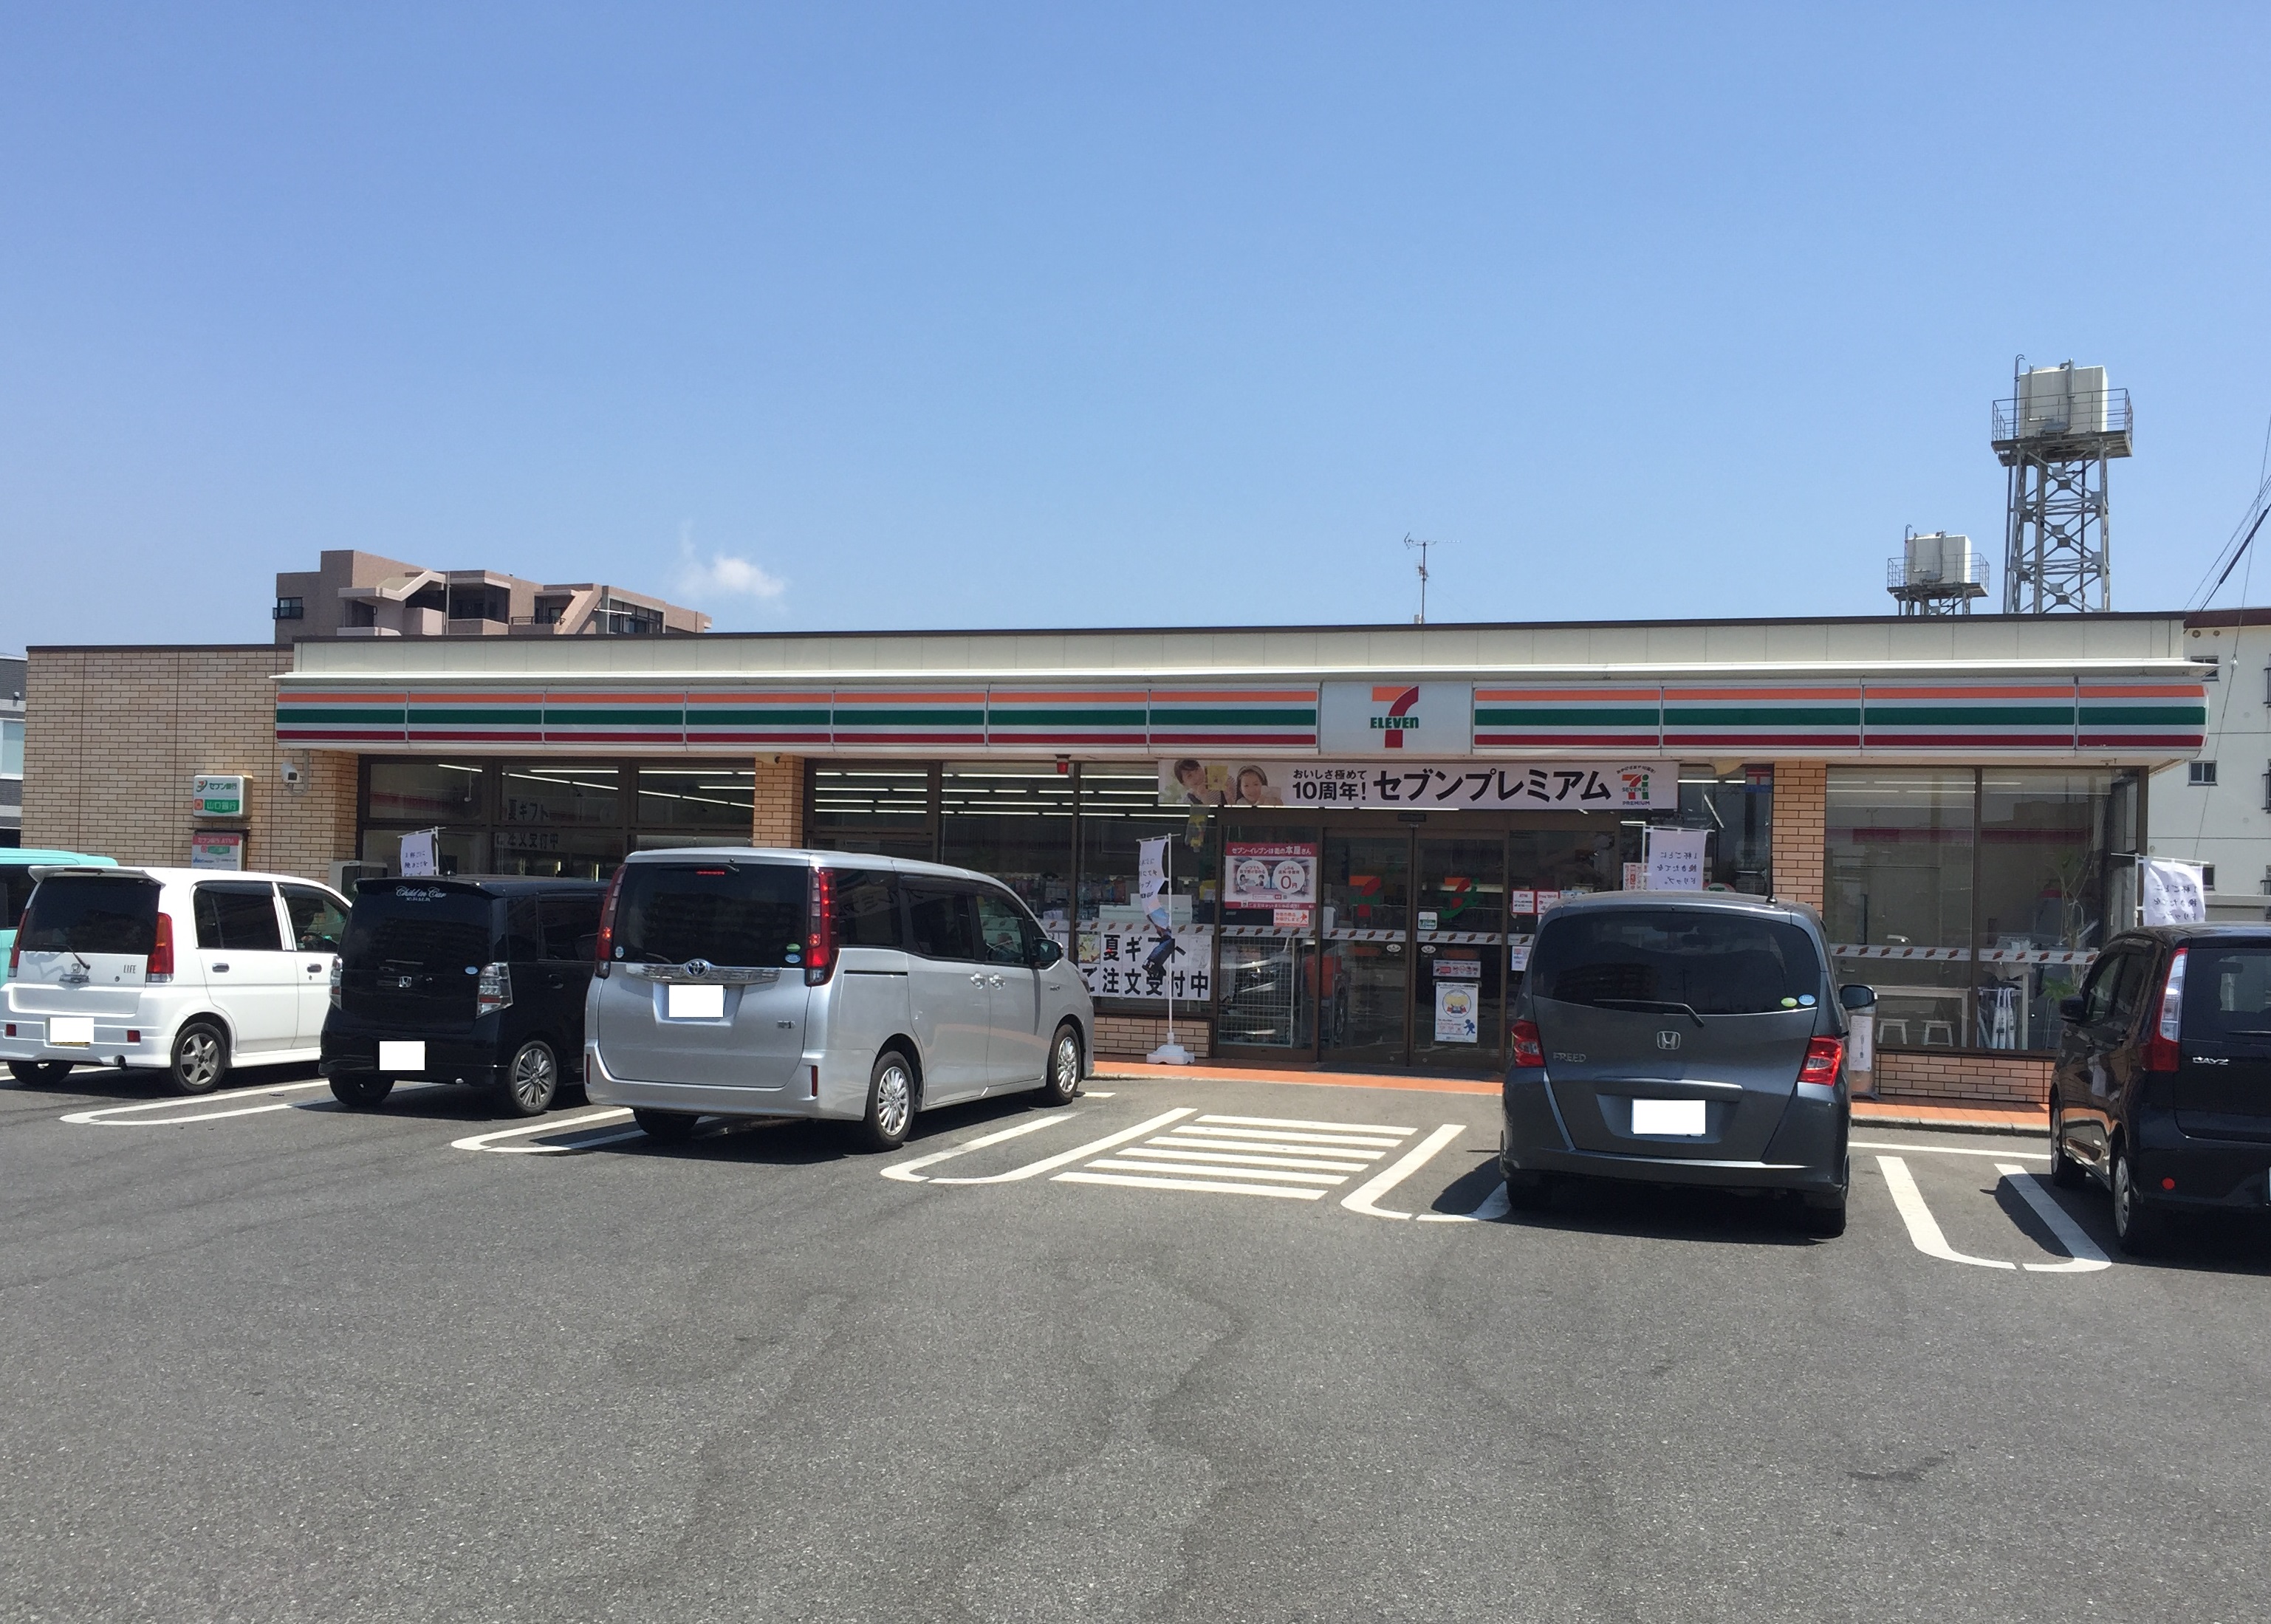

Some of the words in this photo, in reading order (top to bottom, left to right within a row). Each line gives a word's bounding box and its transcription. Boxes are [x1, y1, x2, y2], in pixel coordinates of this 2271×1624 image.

[1293, 769, 1367, 780] おいしさ極めて
[209, 783, 237, 791] セブン銀行
[1292, 781, 1366, 801] 10周年!
[1373, 768, 1611, 803] セブンプレミアム
[207, 802, 236, 811] 山口銀行
[396, 885, 419, 897] Child
[428, 886, 447, 898] Car
[123, 965, 136, 974] LIFE
[1552, 1052, 1586, 1063] FREED
[2193, 1057, 2229, 1066] DAYZ
